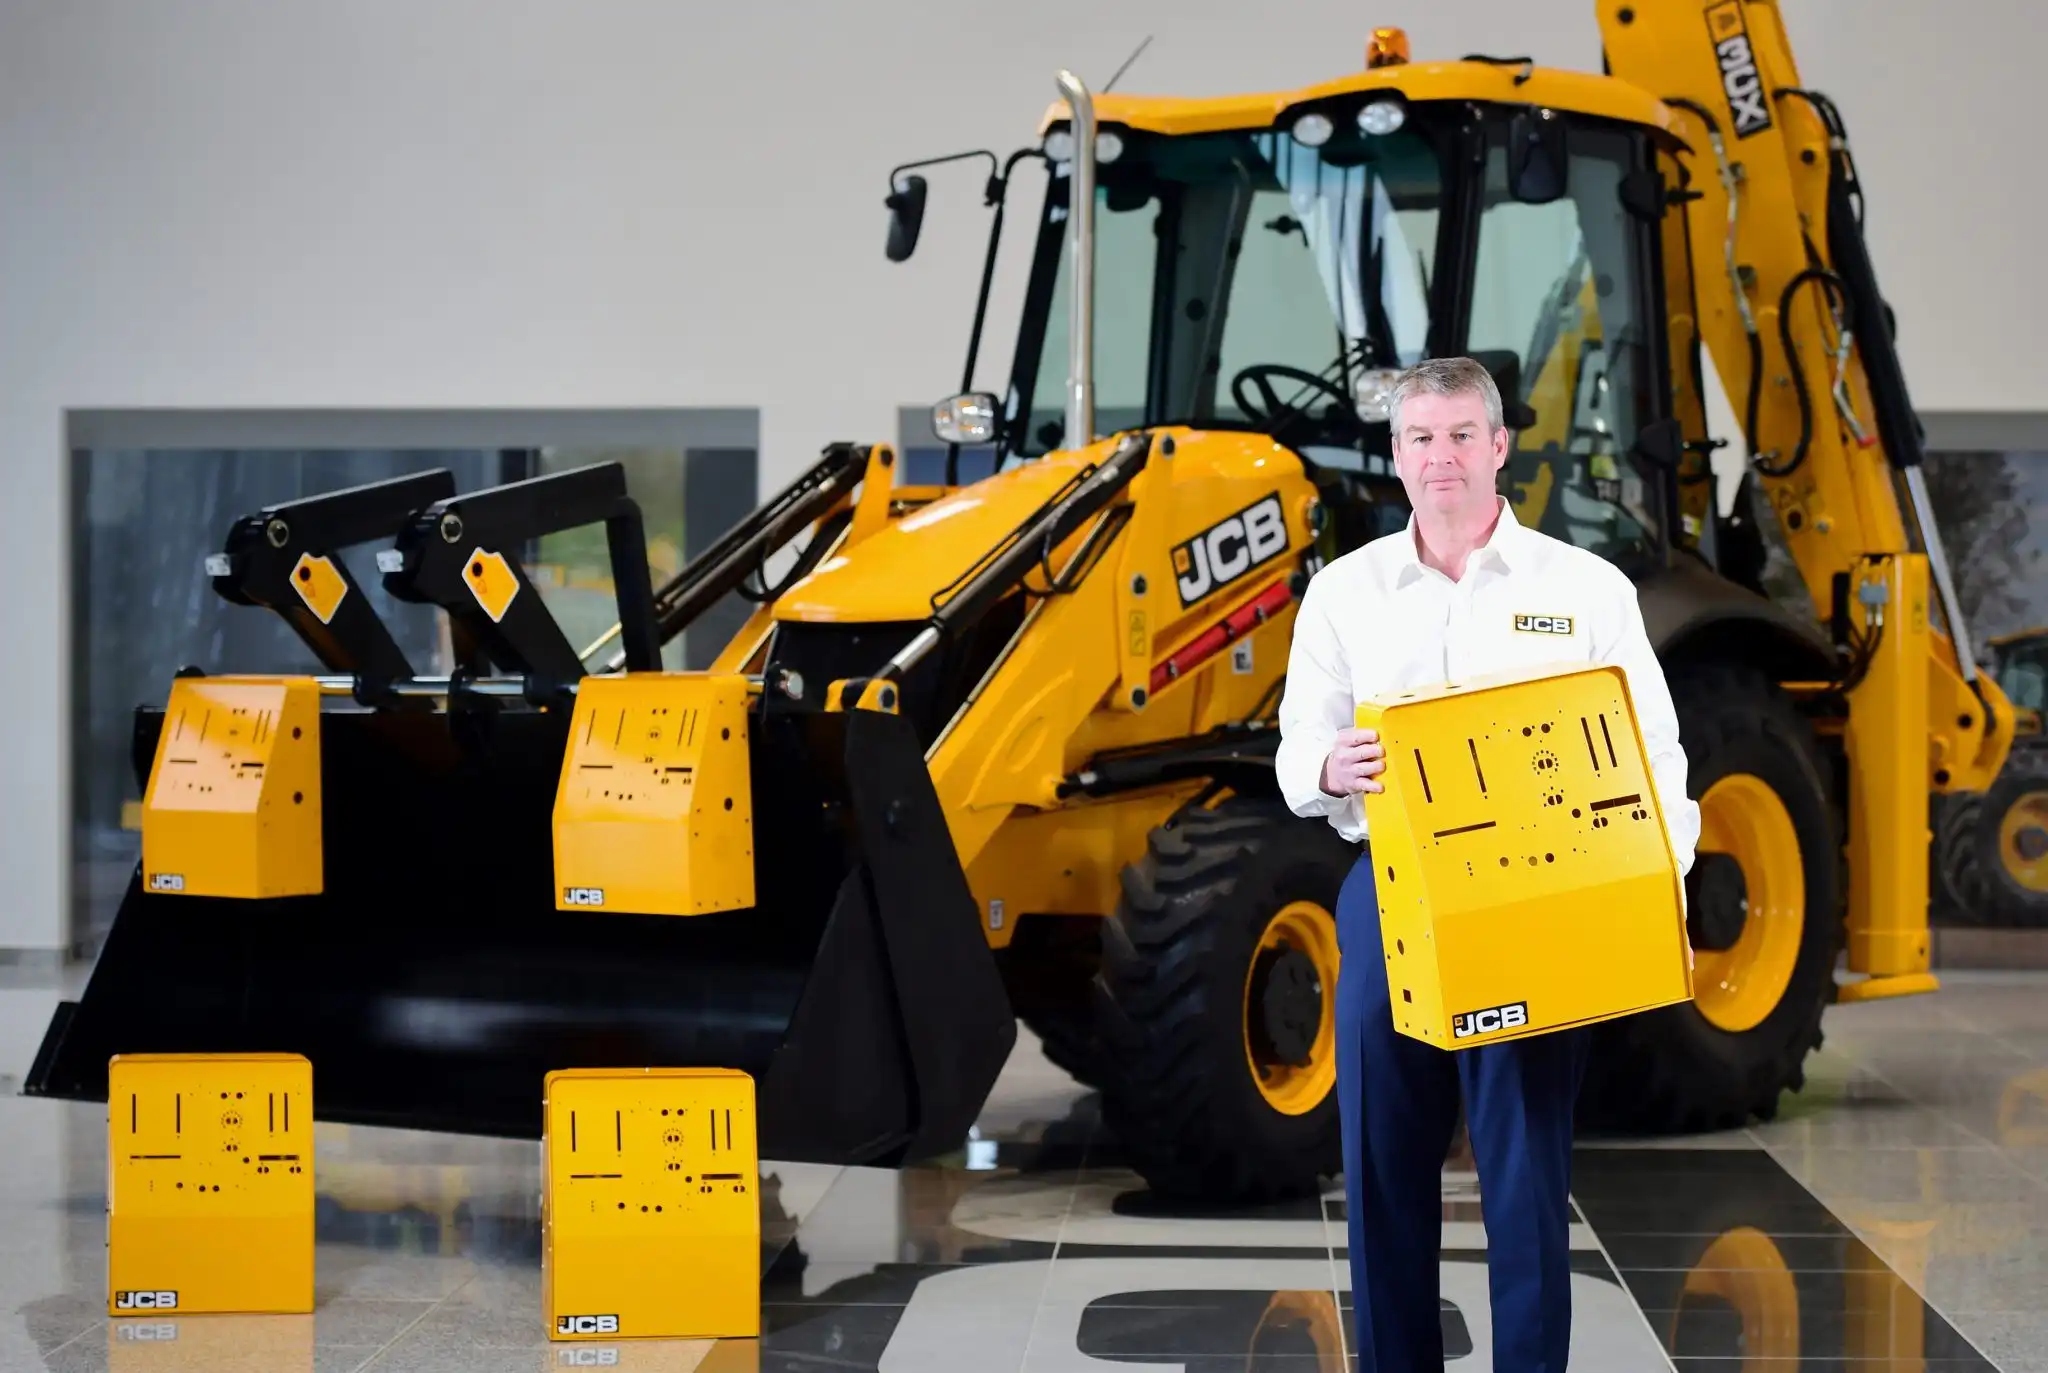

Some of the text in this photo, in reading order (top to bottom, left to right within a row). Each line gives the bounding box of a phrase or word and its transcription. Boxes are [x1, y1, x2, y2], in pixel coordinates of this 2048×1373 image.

[1717, 34, 1768, 128] 3CX
[1179, 497, 1287, 602] JCB
[1517, 616, 1571, 634] JCB
[151, 873, 183, 890] JCB
[564, 888, 603, 906] JCB
[1455, 1004, 1526, 1038] JCB
[117, 1291, 177, 1309] JCB
[557, 1315, 618, 1333] JCB
